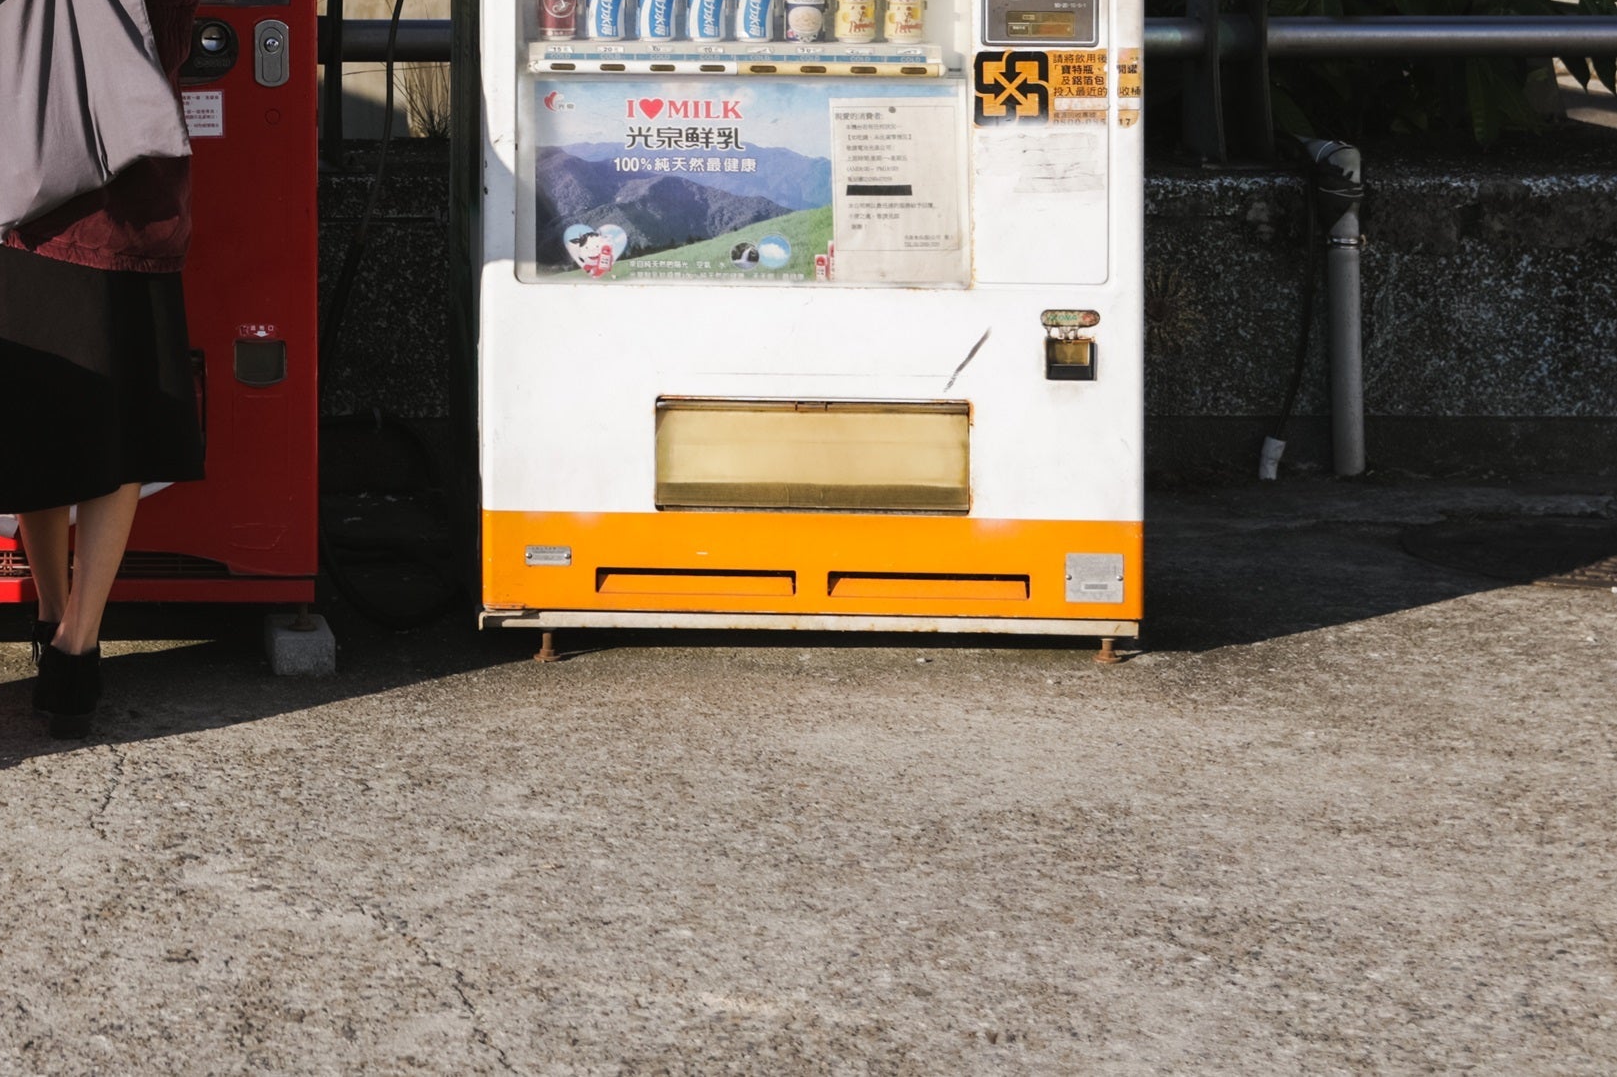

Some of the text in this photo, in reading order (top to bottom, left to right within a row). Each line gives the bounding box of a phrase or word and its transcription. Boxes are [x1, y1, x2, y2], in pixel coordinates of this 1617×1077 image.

[627, 100, 743, 119] I MILK
[627, 126, 744, 150] 光泉鮮乳
[613, 157, 757, 172] 100%純天然最健康
